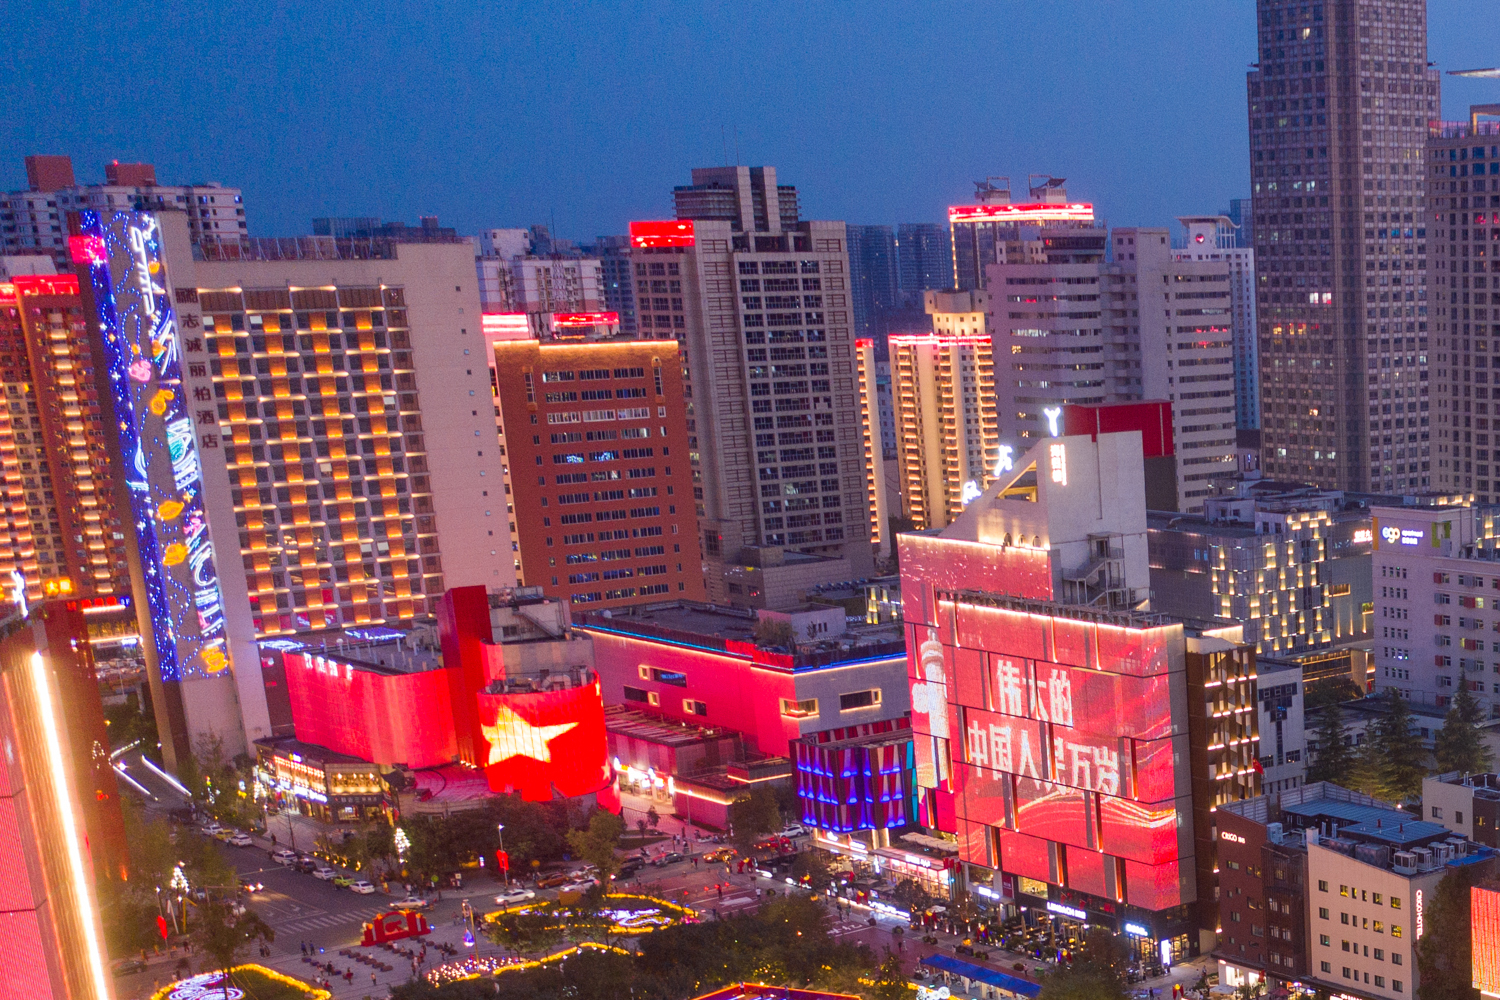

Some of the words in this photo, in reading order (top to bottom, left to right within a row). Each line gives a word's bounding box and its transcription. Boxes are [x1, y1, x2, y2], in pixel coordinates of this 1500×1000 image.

[996, 659, 1074, 728] 伟大的
[968, 720, 1120, 802] 中国人民万岁
